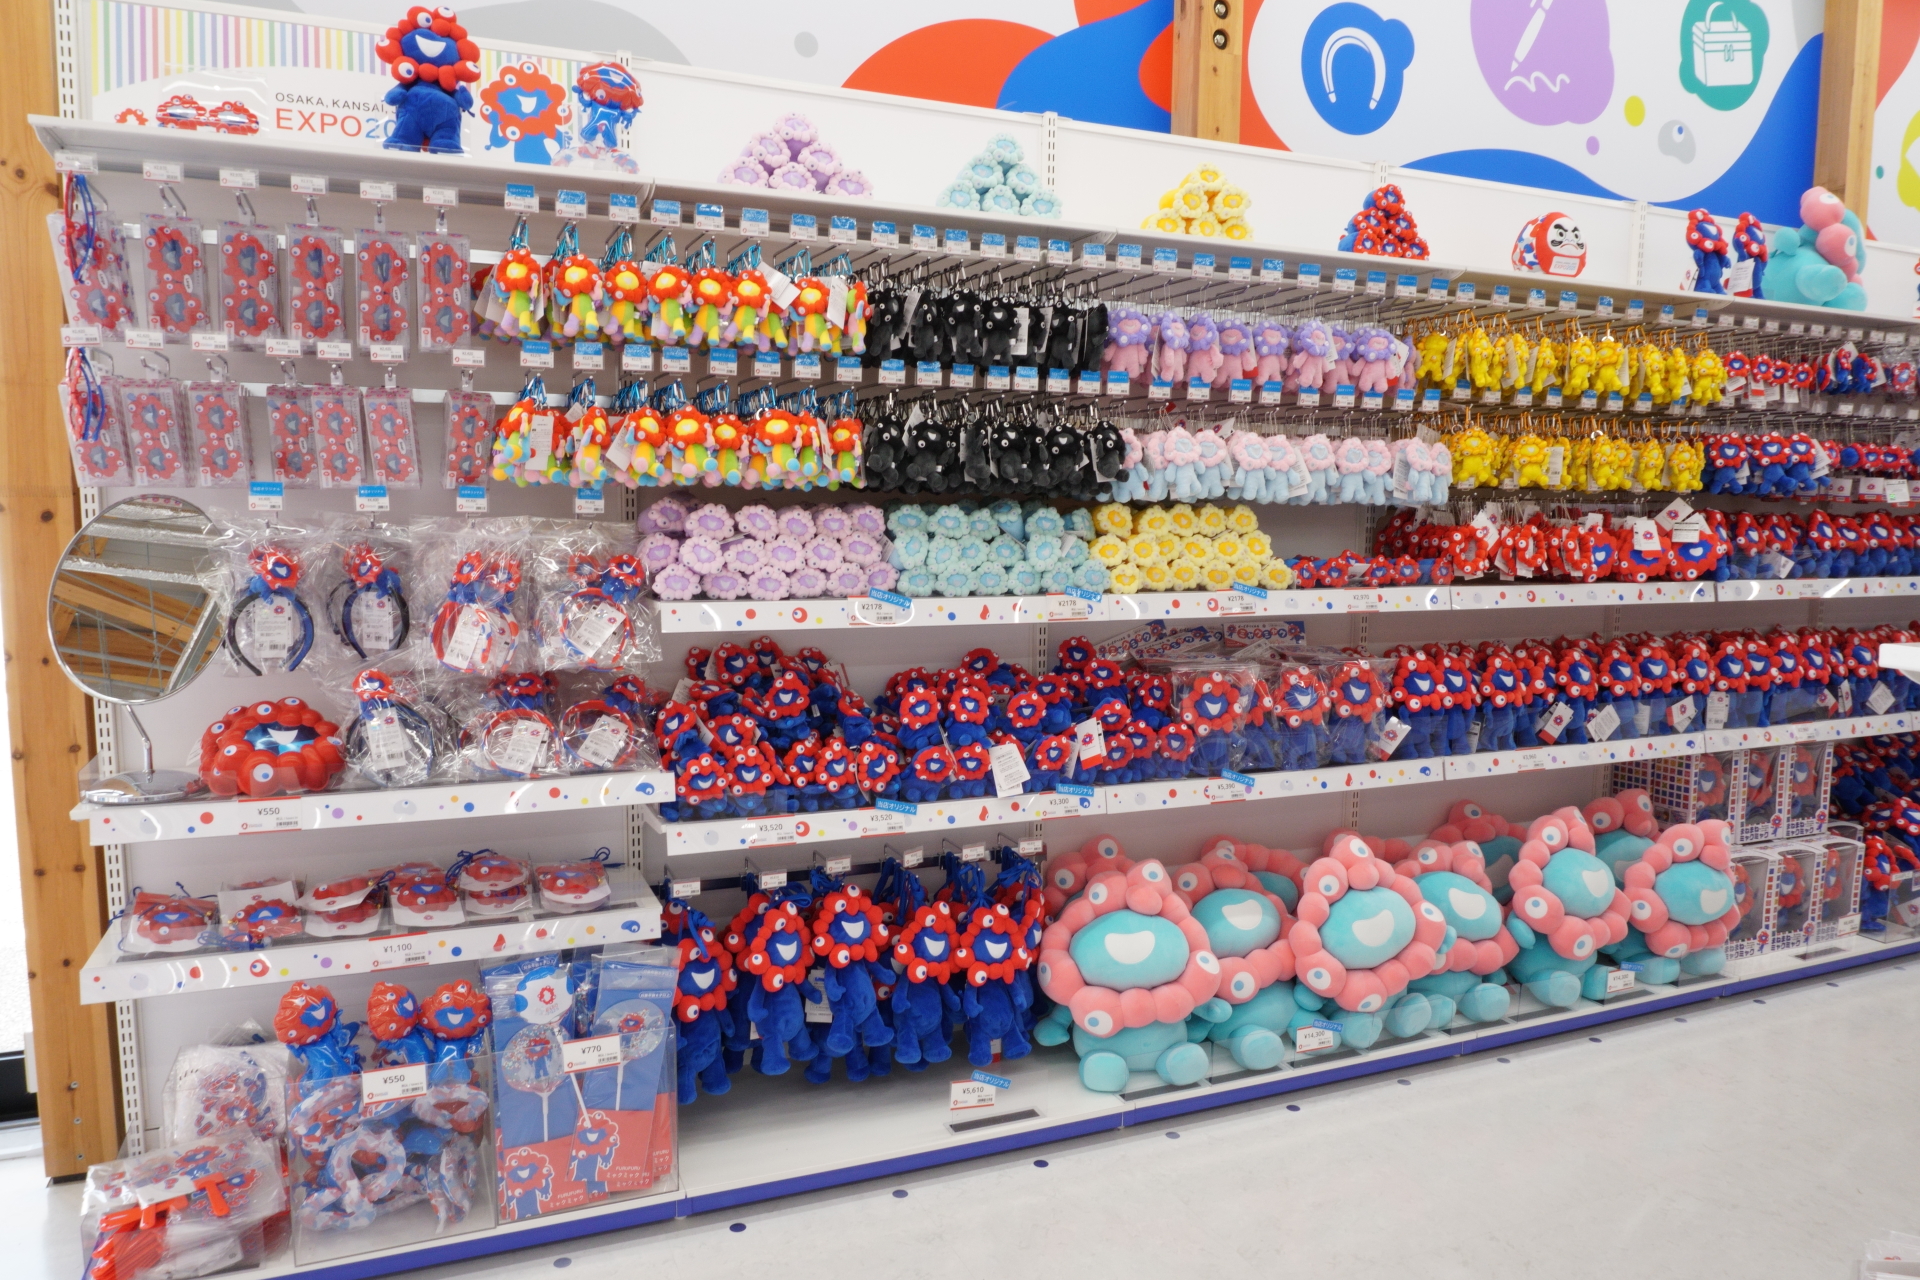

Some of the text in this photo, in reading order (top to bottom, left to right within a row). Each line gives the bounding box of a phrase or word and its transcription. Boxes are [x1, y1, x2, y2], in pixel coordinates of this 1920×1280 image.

[275, 92, 329, 108] OSAKA,
[332, 99, 388, 114] KANSAI,
[276, 108, 397, 139] EXPO20
[871, 589, 911, 607] 当店オリジナル
[877, 799, 917, 813] 当店オリジナル
[1049, 797, 1070, 806] ¥3,300
[257, 807, 280, 816] ¥550
[870, 814, 893, 823] ¥3,520
[759, 823, 783, 832] ¥3,520
[383, 943, 412, 953] ¥1,100
[581, 1045, 602, 1054] ¥770
[383, 1074, 405, 1084] ¥550
[962, 1086, 984, 1095] ¥5,610
[557, 1188, 584, 1199] FURUFURU
[550, 1195, 584, 1208] ミャクミャク
